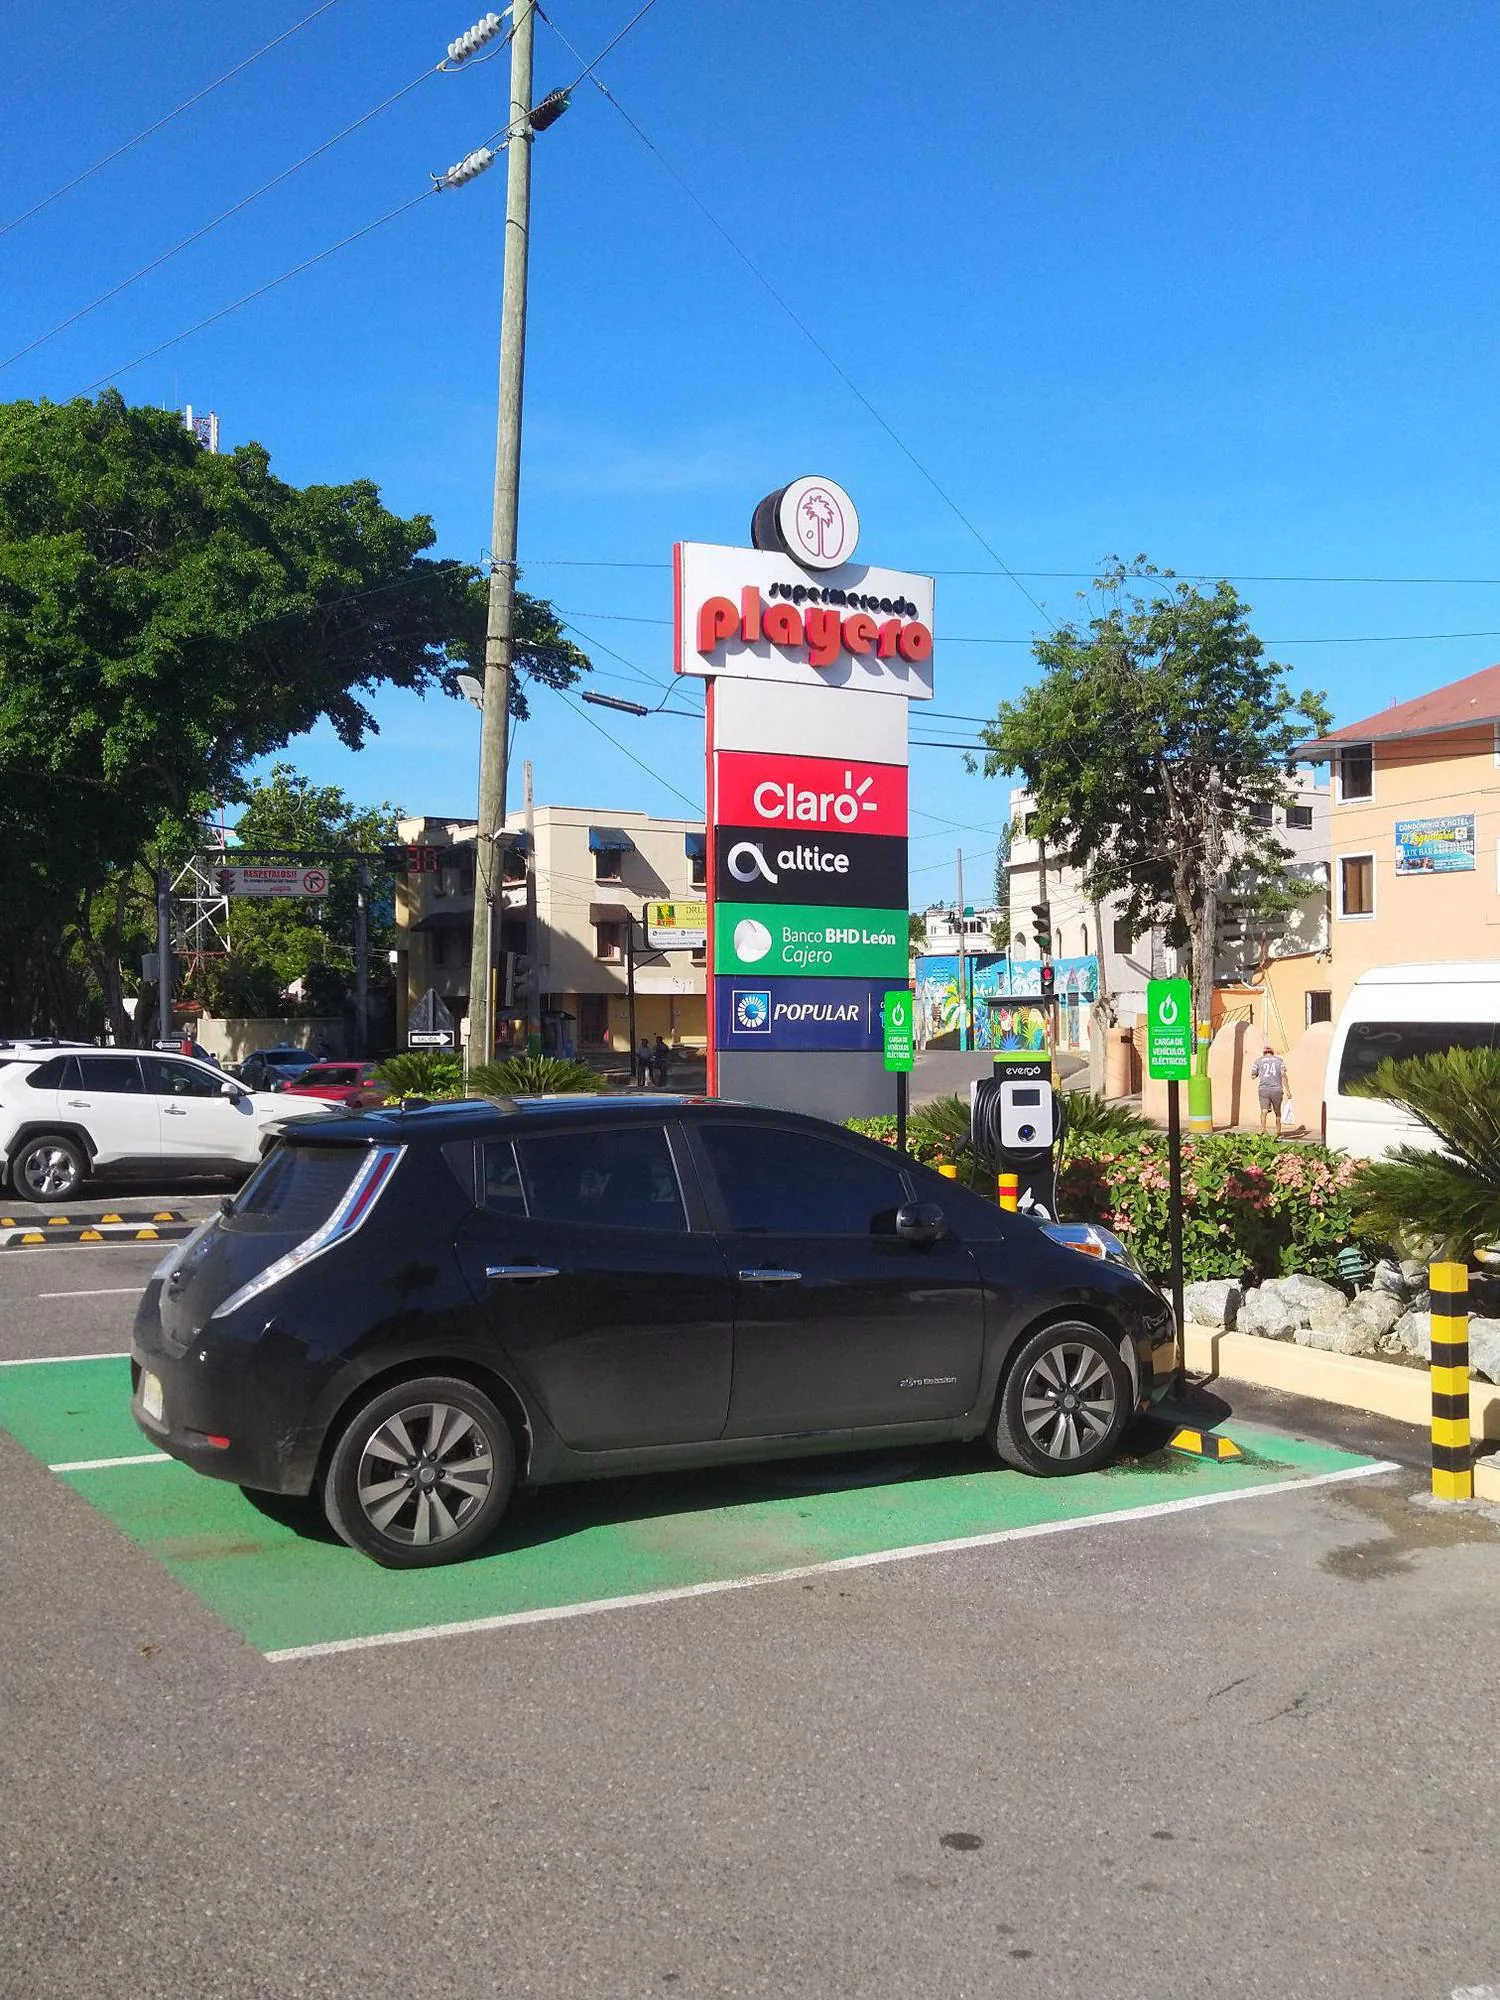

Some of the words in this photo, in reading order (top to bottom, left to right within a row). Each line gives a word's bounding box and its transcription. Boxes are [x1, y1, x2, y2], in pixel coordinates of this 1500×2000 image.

[768, 582, 918, 617] supermercado
[697, 585, 933, 667] playero
[753, 781, 858, 824] Claro
[777, 845, 850, 873] altice
[782, 926, 822, 943] Banco
[825, 928, 860, 944] BHD
[862, 929, 897, 945] León
[782, 946, 833, 968] Cajero
[774, 1004, 860, 1021] POPULAR
[1153, 1037, 1174, 1046] CARGA
[1174, 1037, 1184, 1046] DE
[1263, 1062, 1277, 1078] 24
